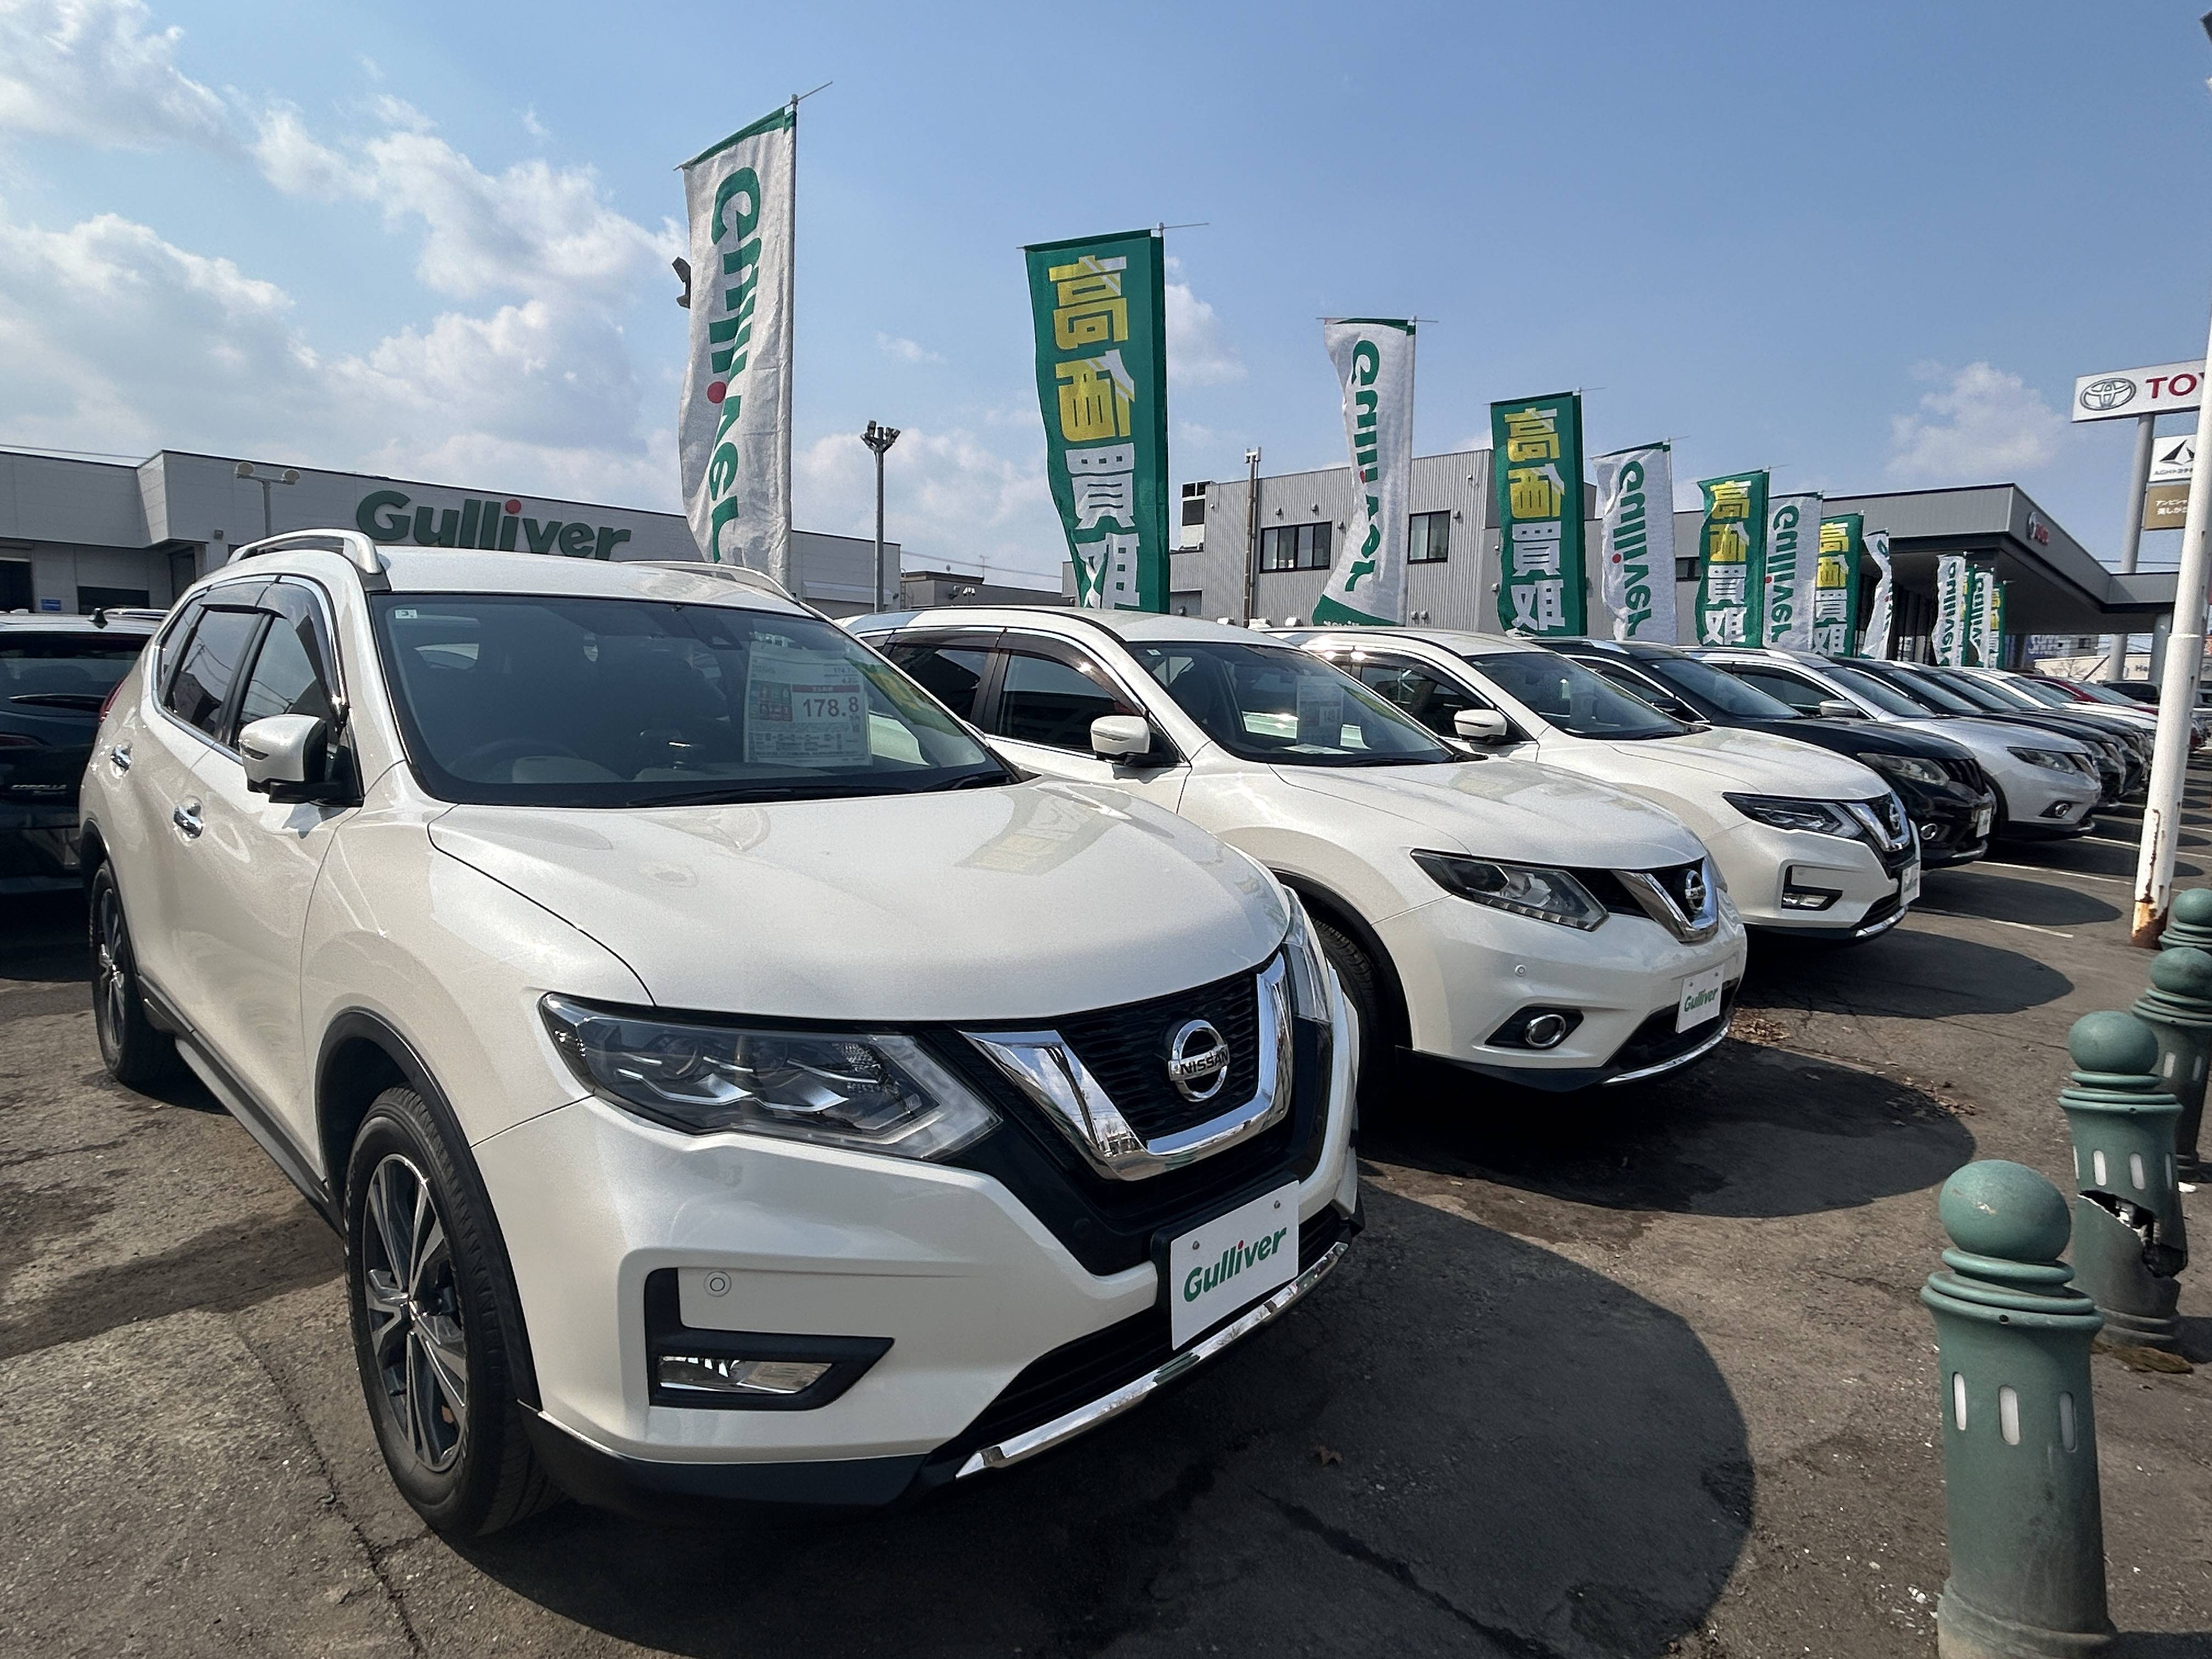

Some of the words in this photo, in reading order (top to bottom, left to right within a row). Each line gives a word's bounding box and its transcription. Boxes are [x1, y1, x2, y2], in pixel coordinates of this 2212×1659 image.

[356, 490, 631, 561] Gulliver
[803, 697, 859, 717] 178.8
[1684, 988, 1718, 1012] Gulliver
[1180, 1048, 1228, 1075] NISSAN
[1183, 1226, 1287, 1302] Gulliver
